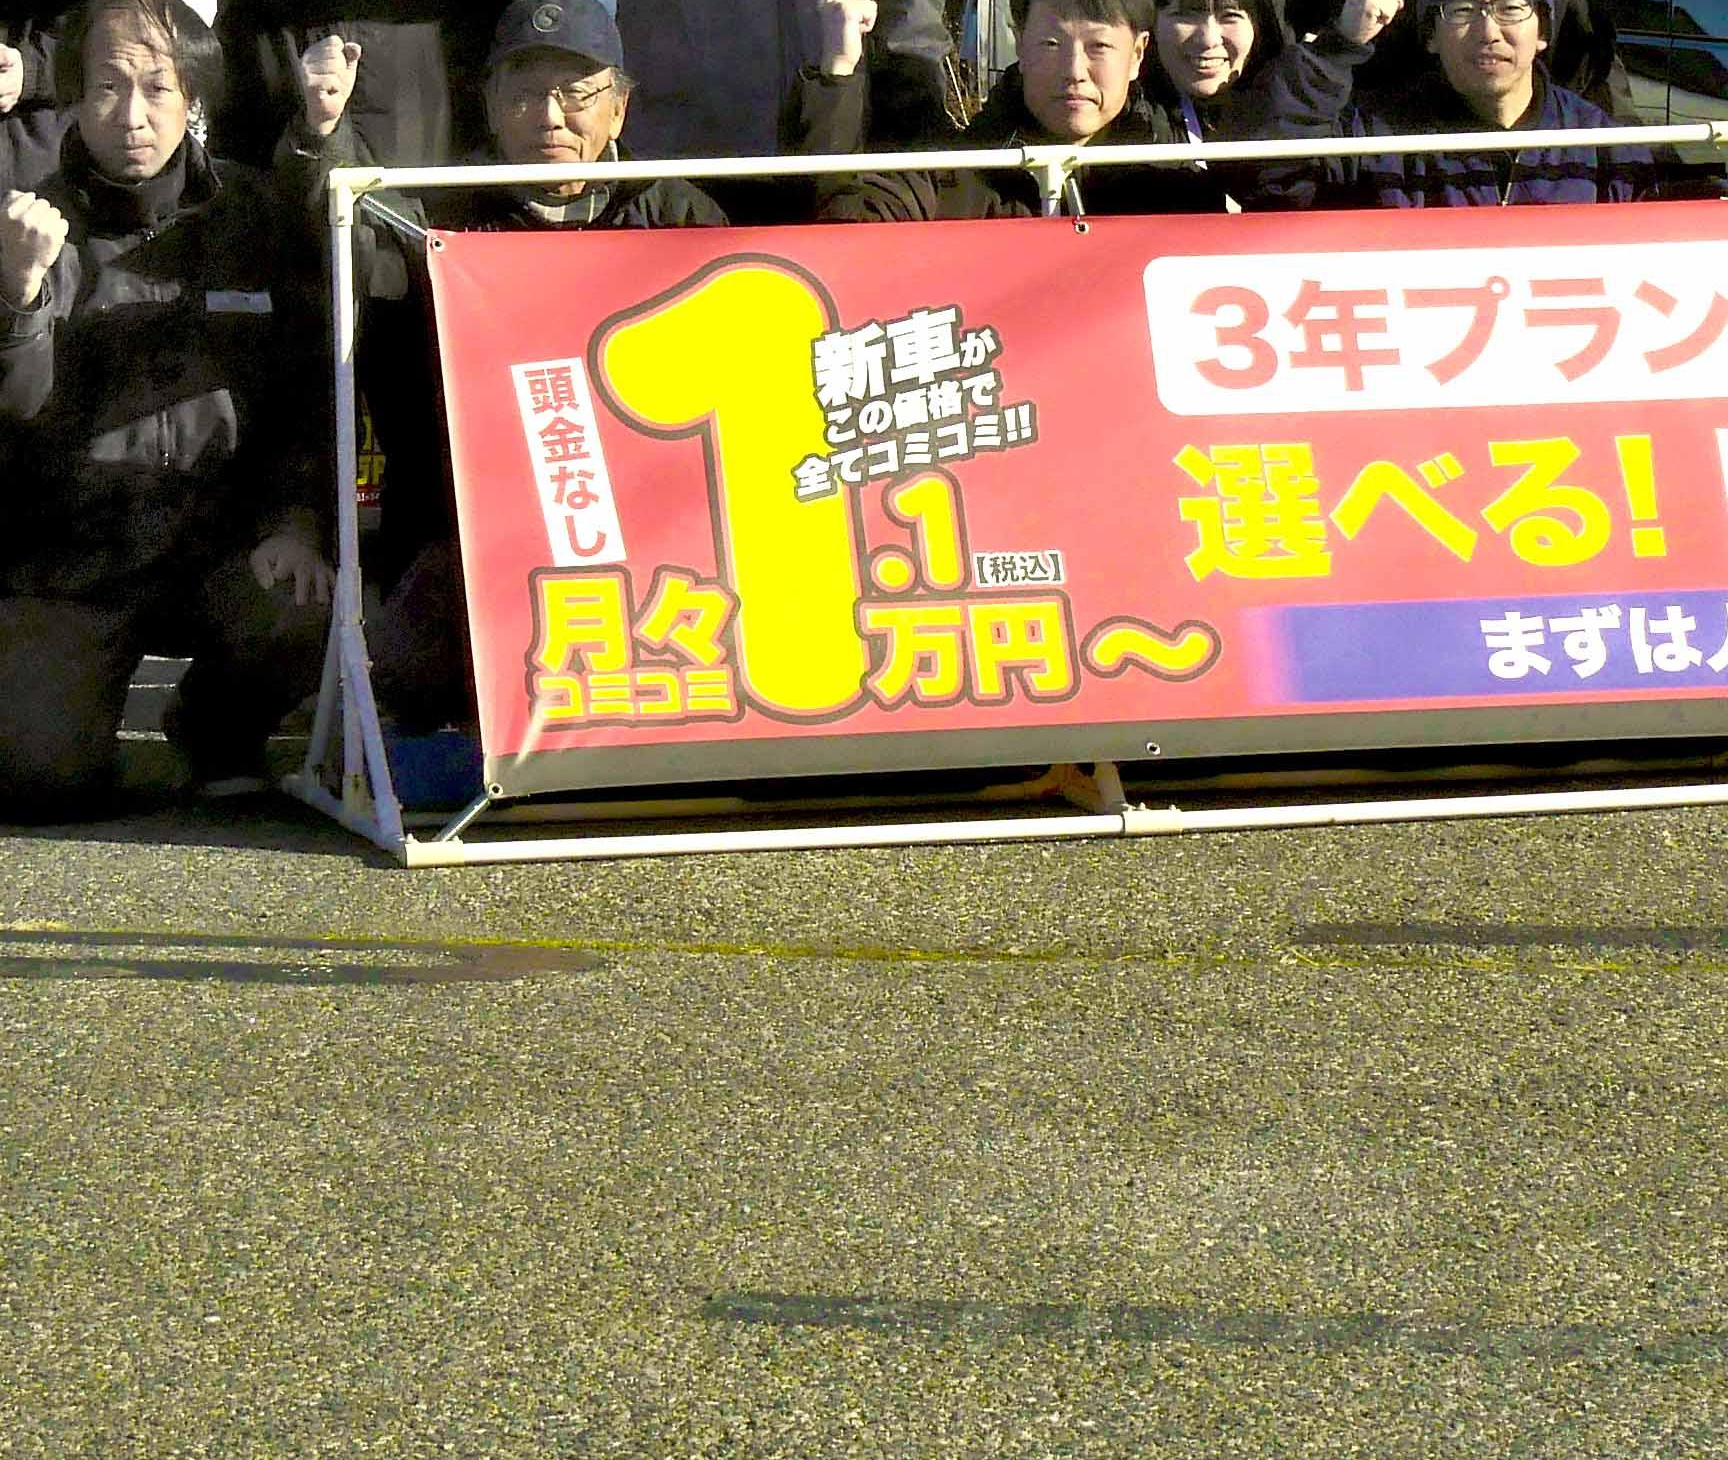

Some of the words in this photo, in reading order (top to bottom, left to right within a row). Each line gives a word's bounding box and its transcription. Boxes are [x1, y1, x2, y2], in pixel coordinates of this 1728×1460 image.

[813, 308, 997, 405] 新車が
[794, 402, 1035, 498] 全てコミコミ!!
[824, 376, 994, 440] この価格で
[521, 367, 607, 558] 頭金なし
[1172, 433, 1669, 584] 選べる!
[540, 574, 736, 672] 月々
[538, 671, 735, 720] コミコミ
